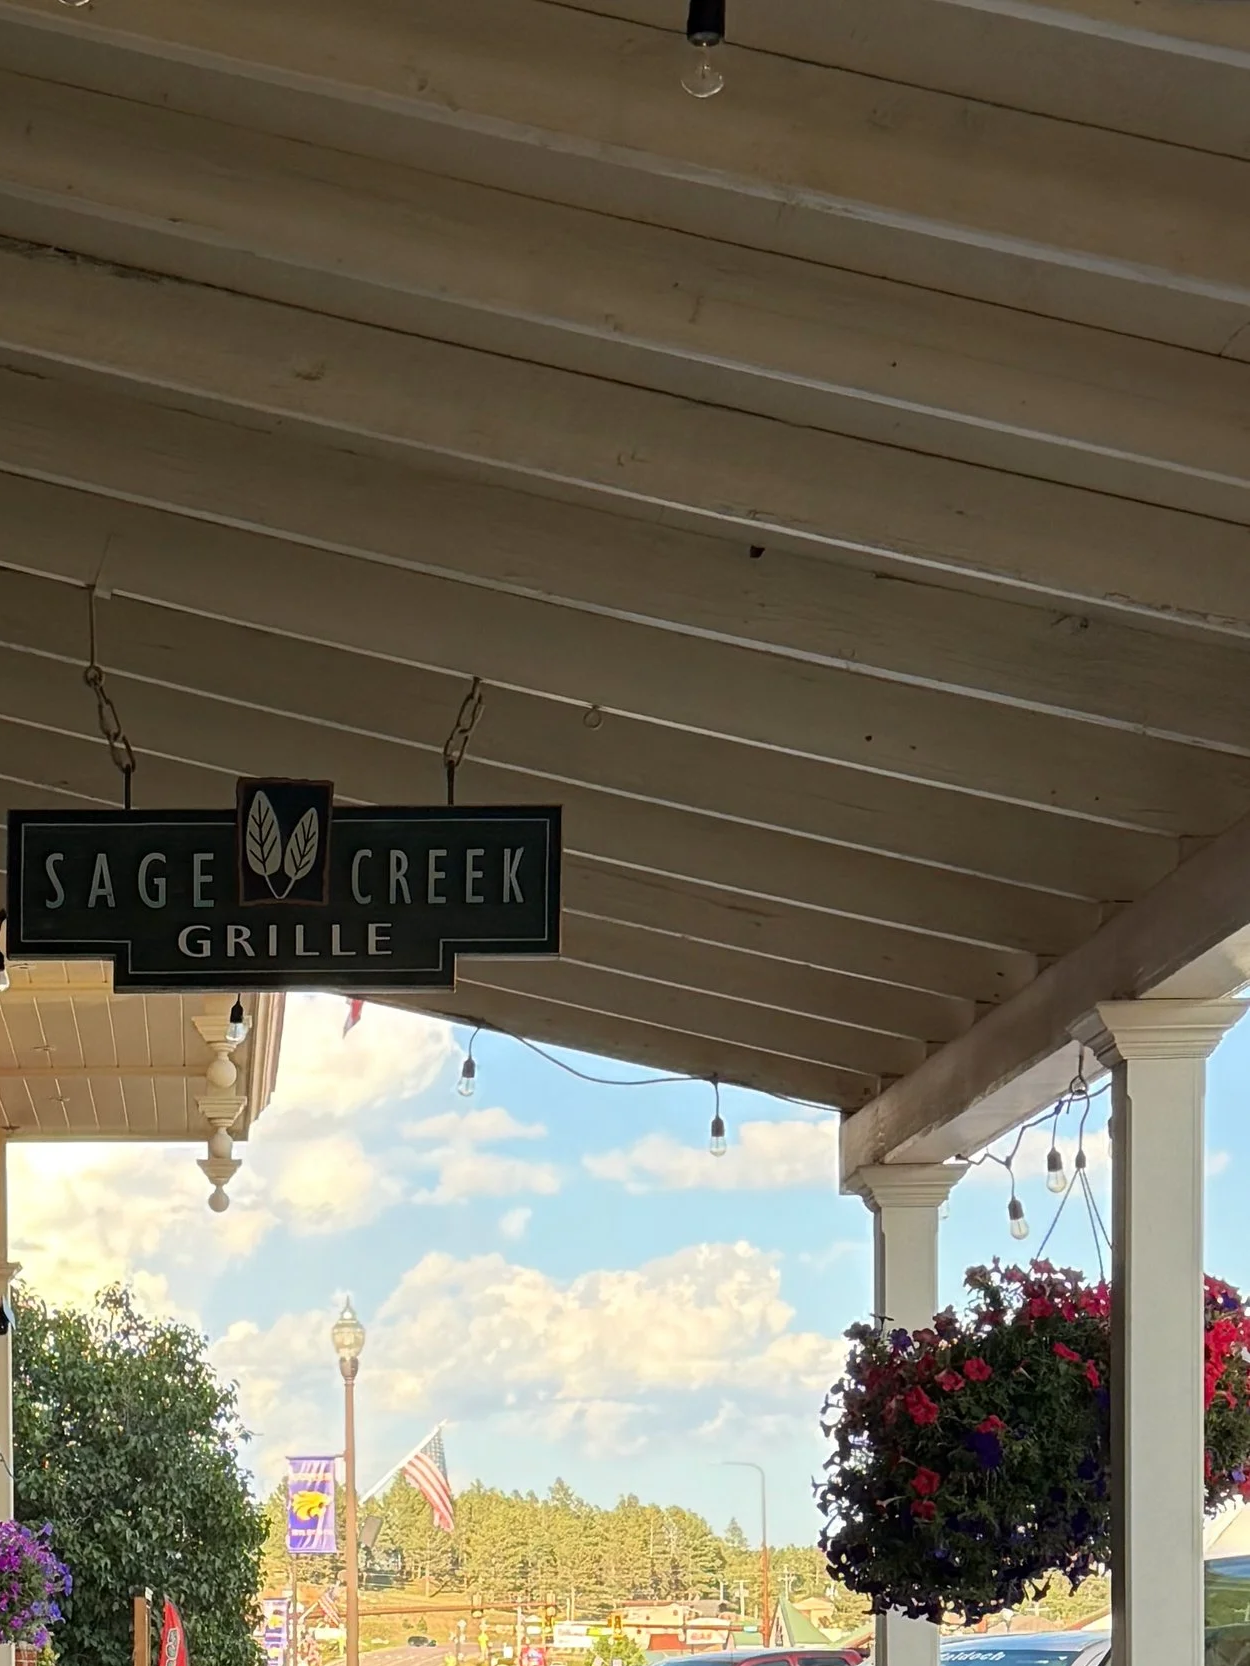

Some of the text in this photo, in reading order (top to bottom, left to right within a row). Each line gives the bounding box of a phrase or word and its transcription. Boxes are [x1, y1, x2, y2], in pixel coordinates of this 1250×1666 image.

[44, 846, 525, 910] SAGE CREEK
[177, 922, 394, 958] GRILLE
